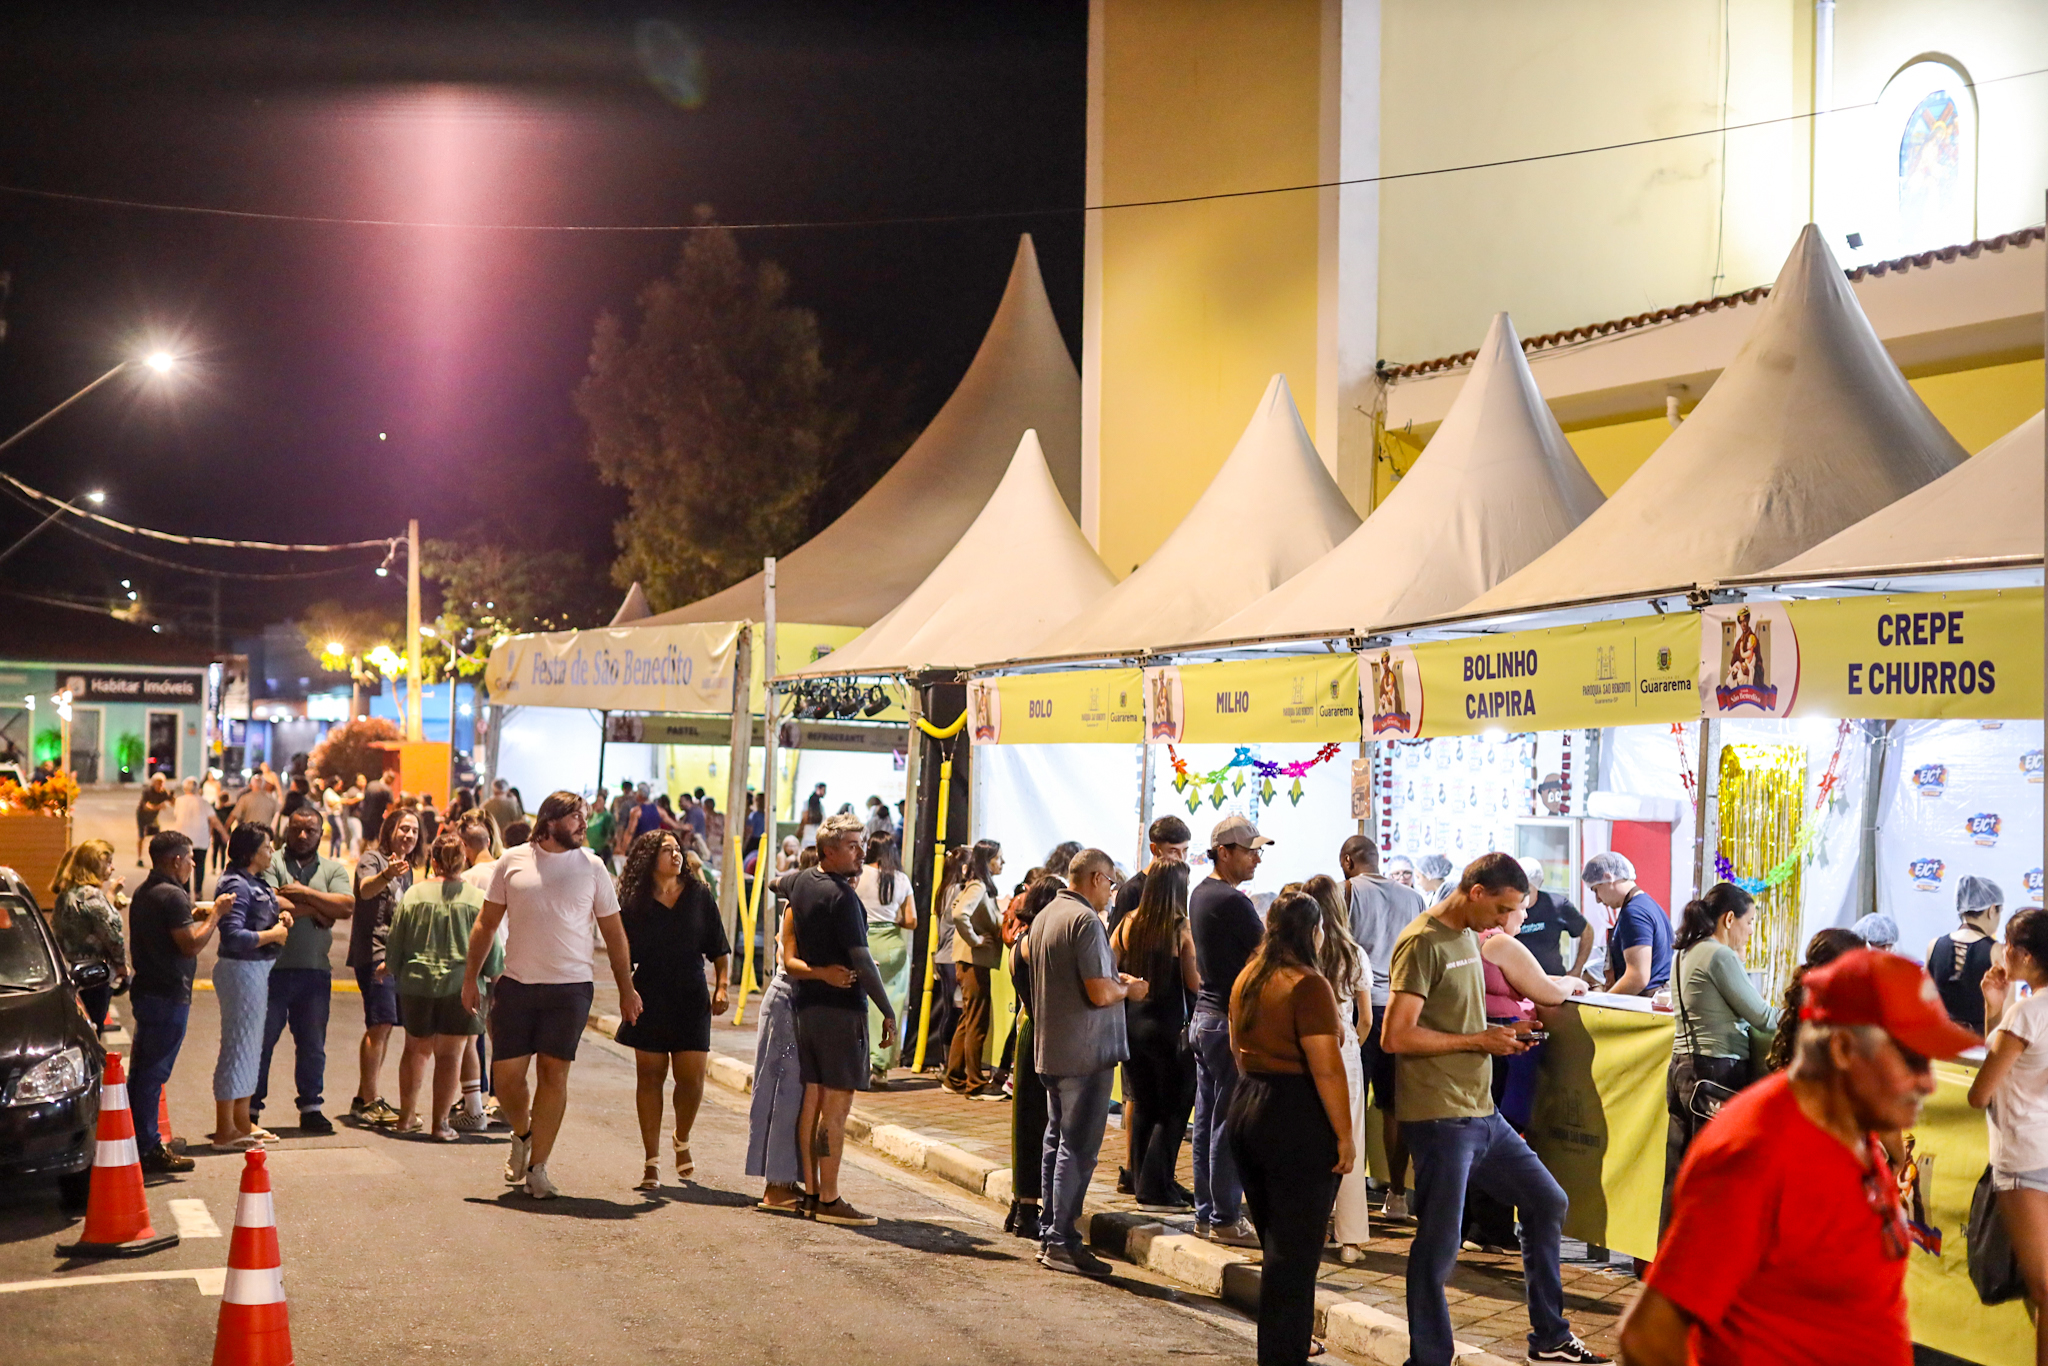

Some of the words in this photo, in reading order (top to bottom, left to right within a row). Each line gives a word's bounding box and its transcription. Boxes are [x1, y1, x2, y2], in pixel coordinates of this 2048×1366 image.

[1877, 611, 1964, 647] CREPE
[531, 651, 567, 685] Festa
[570, 648, 589, 686] de
[622, 644, 693, 686] Benedito
[1463, 649, 1538, 682] BOLINHO
[91, 677, 141, 693] Habitar
[143, 679, 195, 695] Imóveis
[1640, 679, 1692, 694] Guararema
[1848, 663, 1863, 695] E
[1868, 660, 1996, 695] CHURROS
[1028, 699, 1053, 719] BOLO
[1216, 690, 1250, 714] MILHO
[1319, 705, 1354, 717] Guararema
[1465, 689, 1537, 720] CAIPIRA
[1110, 712, 1138, 723] Guararema
[667, 726, 699, 736] PASTEL
